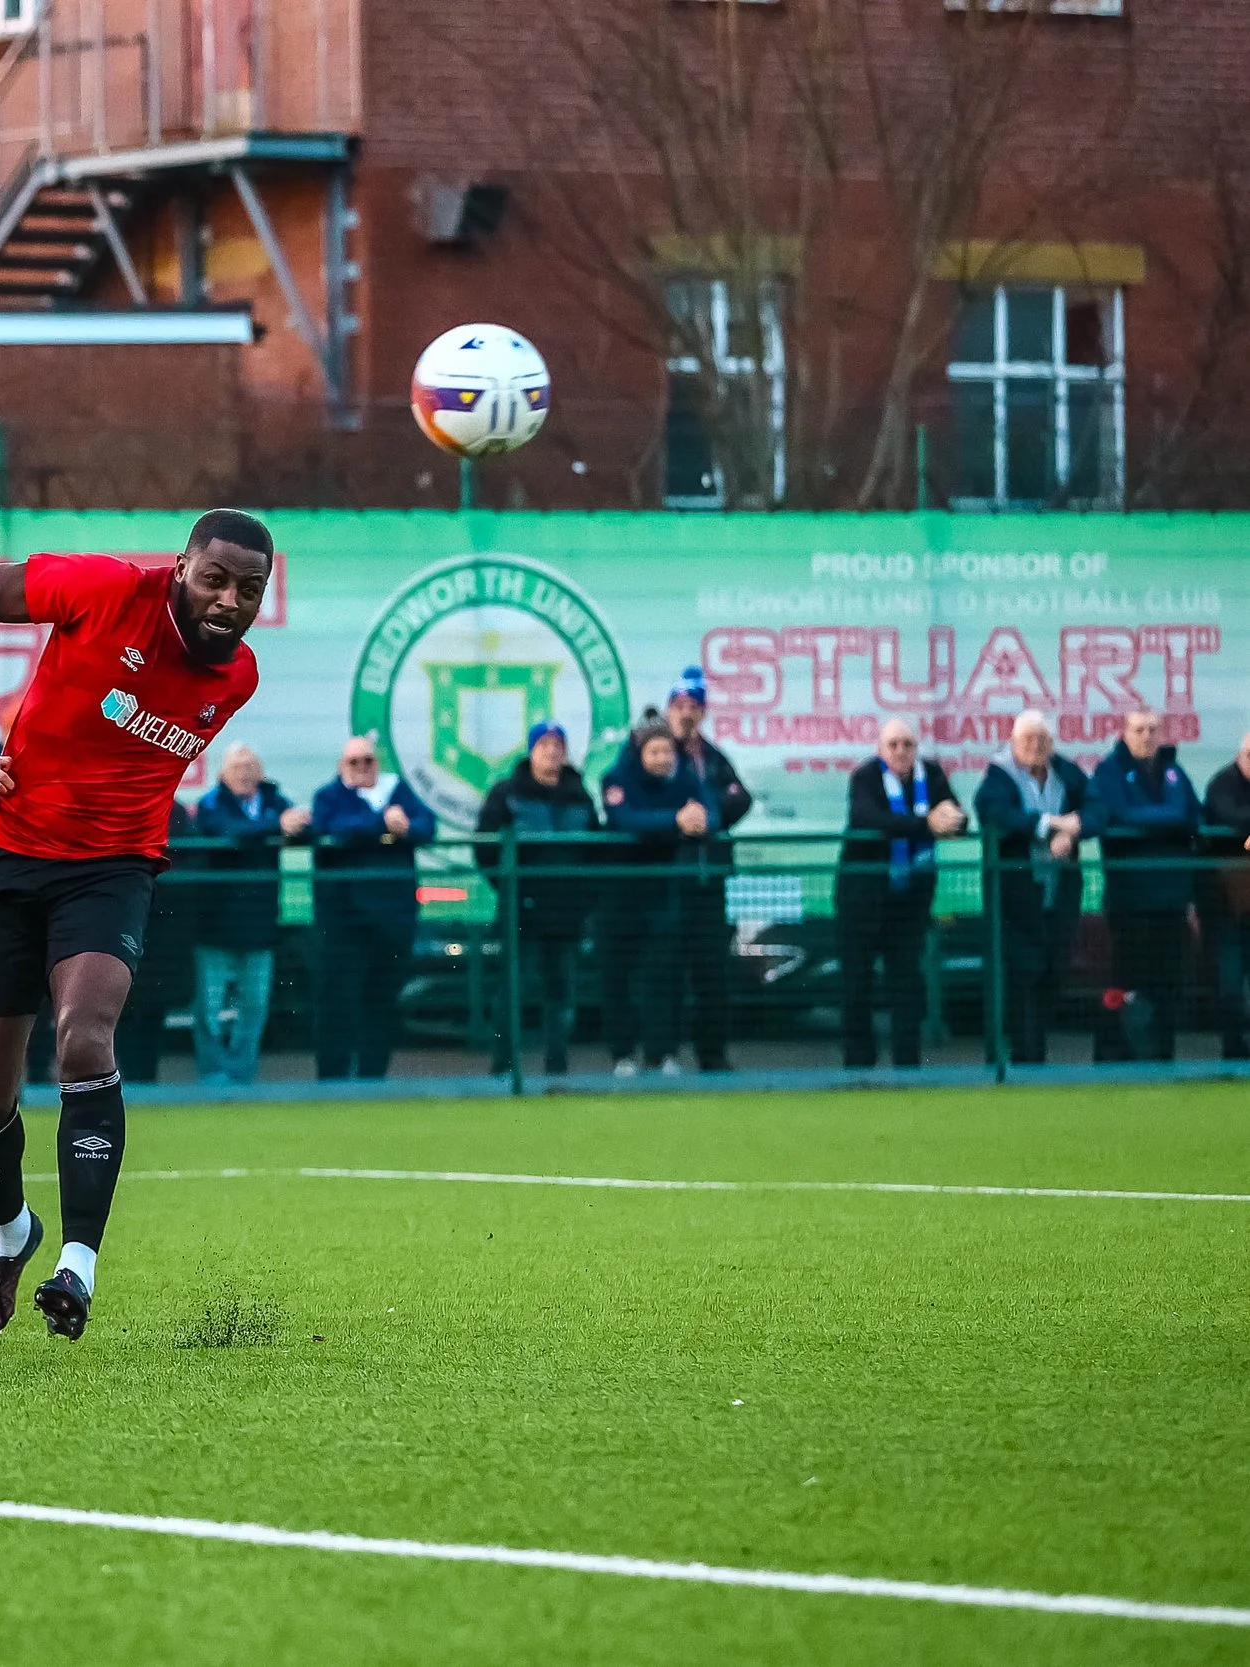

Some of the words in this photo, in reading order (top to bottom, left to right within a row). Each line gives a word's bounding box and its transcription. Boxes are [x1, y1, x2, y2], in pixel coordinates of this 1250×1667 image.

[811, 552, 915, 581] PROUD
[1069, 552, 1109, 581] OF
[985, 586, 1136, 617] FOOTBALL
[1144, 586, 1221, 615] CLUB
[532, 580, 622, 697] UNITED
[119, 655, 138, 672] umbro
[702, 623, 1221, 712] STUART
[126, 711, 206, 759] AXELBOOKS
[715, 714, 878, 744] PLUMBING
[75, 1151, 109, 1160] umbro
